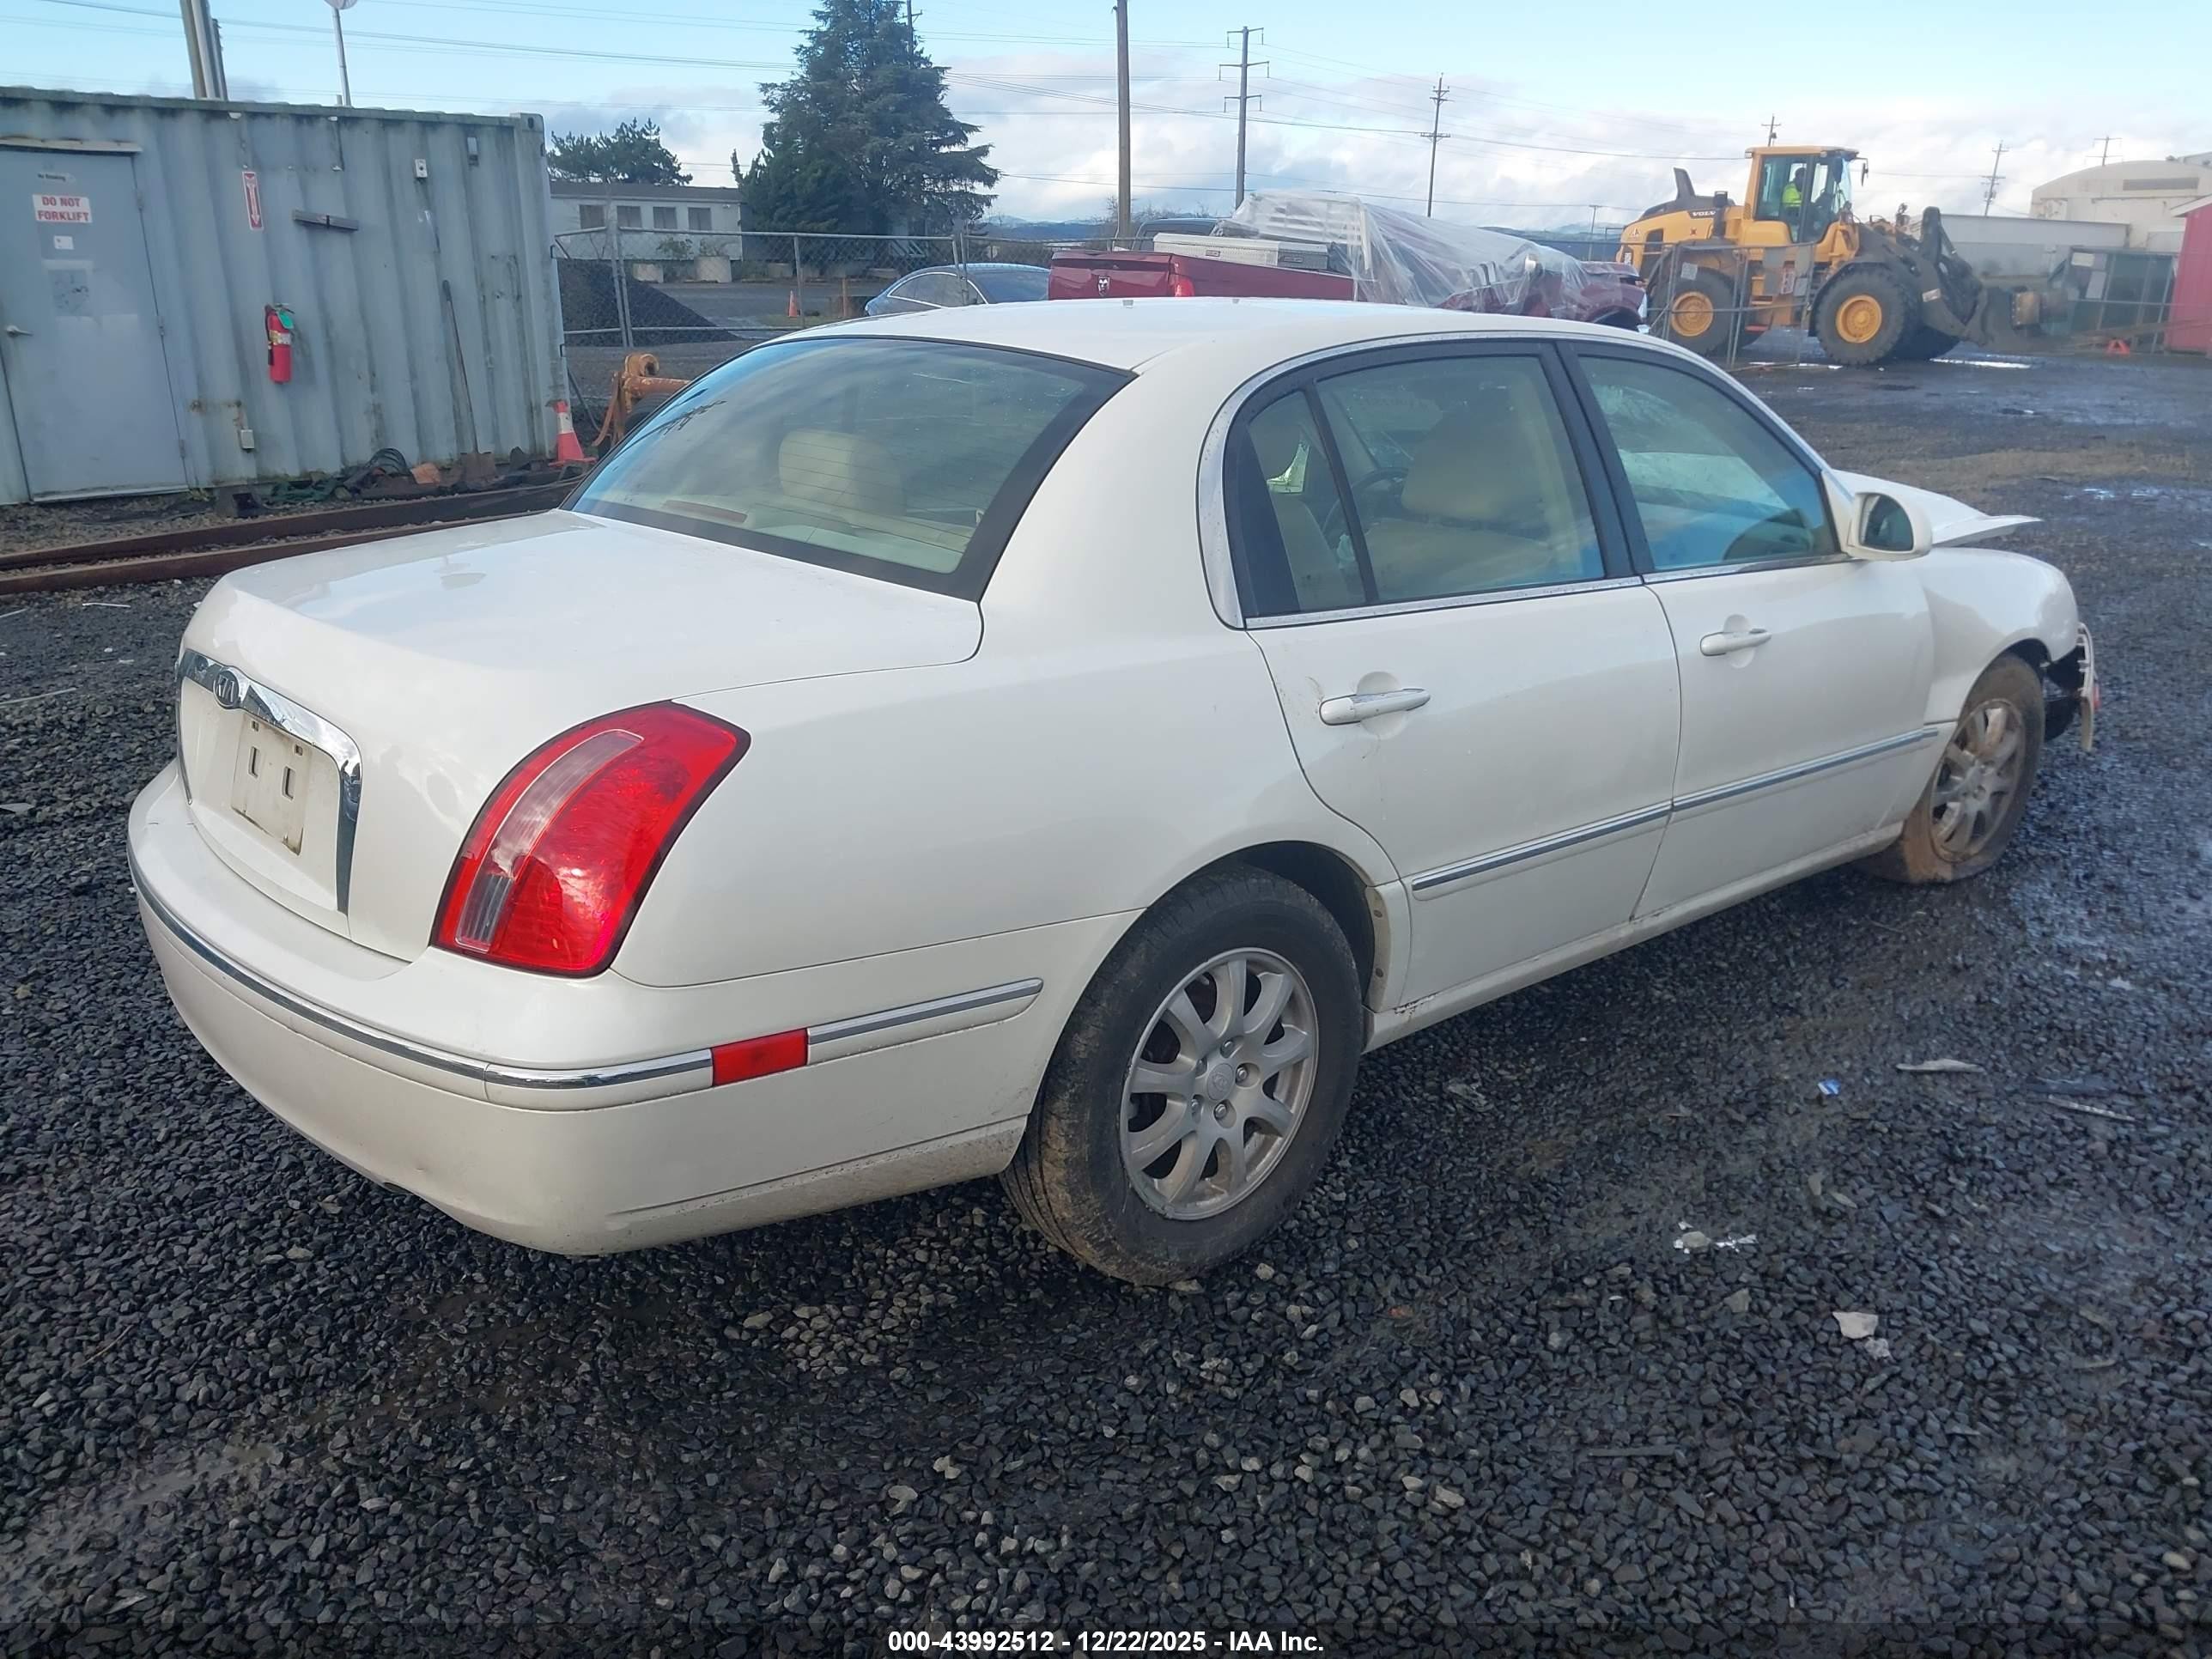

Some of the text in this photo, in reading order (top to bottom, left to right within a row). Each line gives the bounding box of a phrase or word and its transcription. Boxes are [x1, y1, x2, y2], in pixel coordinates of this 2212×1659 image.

[41, 196, 82, 208] DO NOT
[37, 210, 89, 222] FORKLIFT
